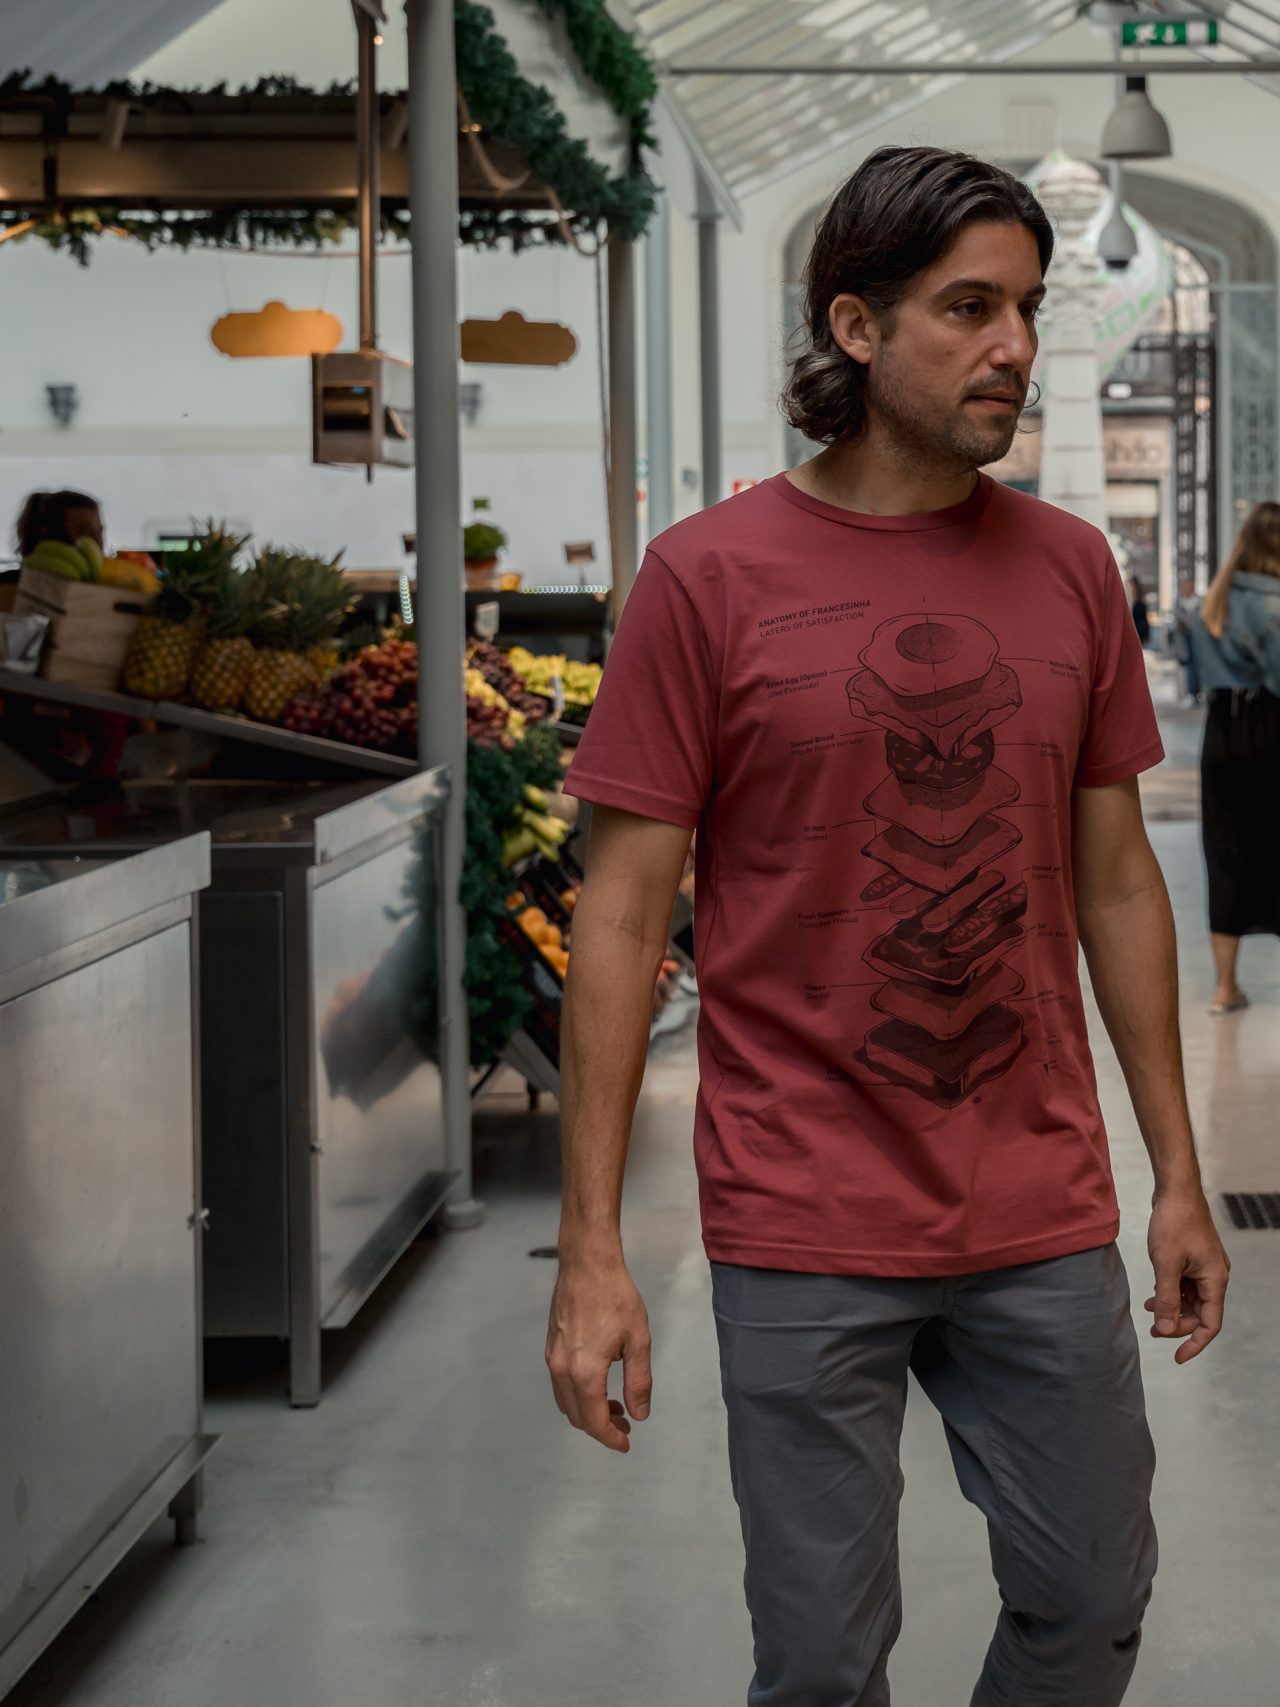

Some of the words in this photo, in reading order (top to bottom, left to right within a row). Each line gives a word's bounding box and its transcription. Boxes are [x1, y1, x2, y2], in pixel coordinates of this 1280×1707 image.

[758, 613, 797, 629] ANATOMY
[799, 610, 811, 619] OF
[812, 599, 871, 617] FRANCESINHA
[760, 624, 792, 639] LAYERS
[793, 621, 804, 631] OF
[806, 611, 864, 627] SATISFACTION
